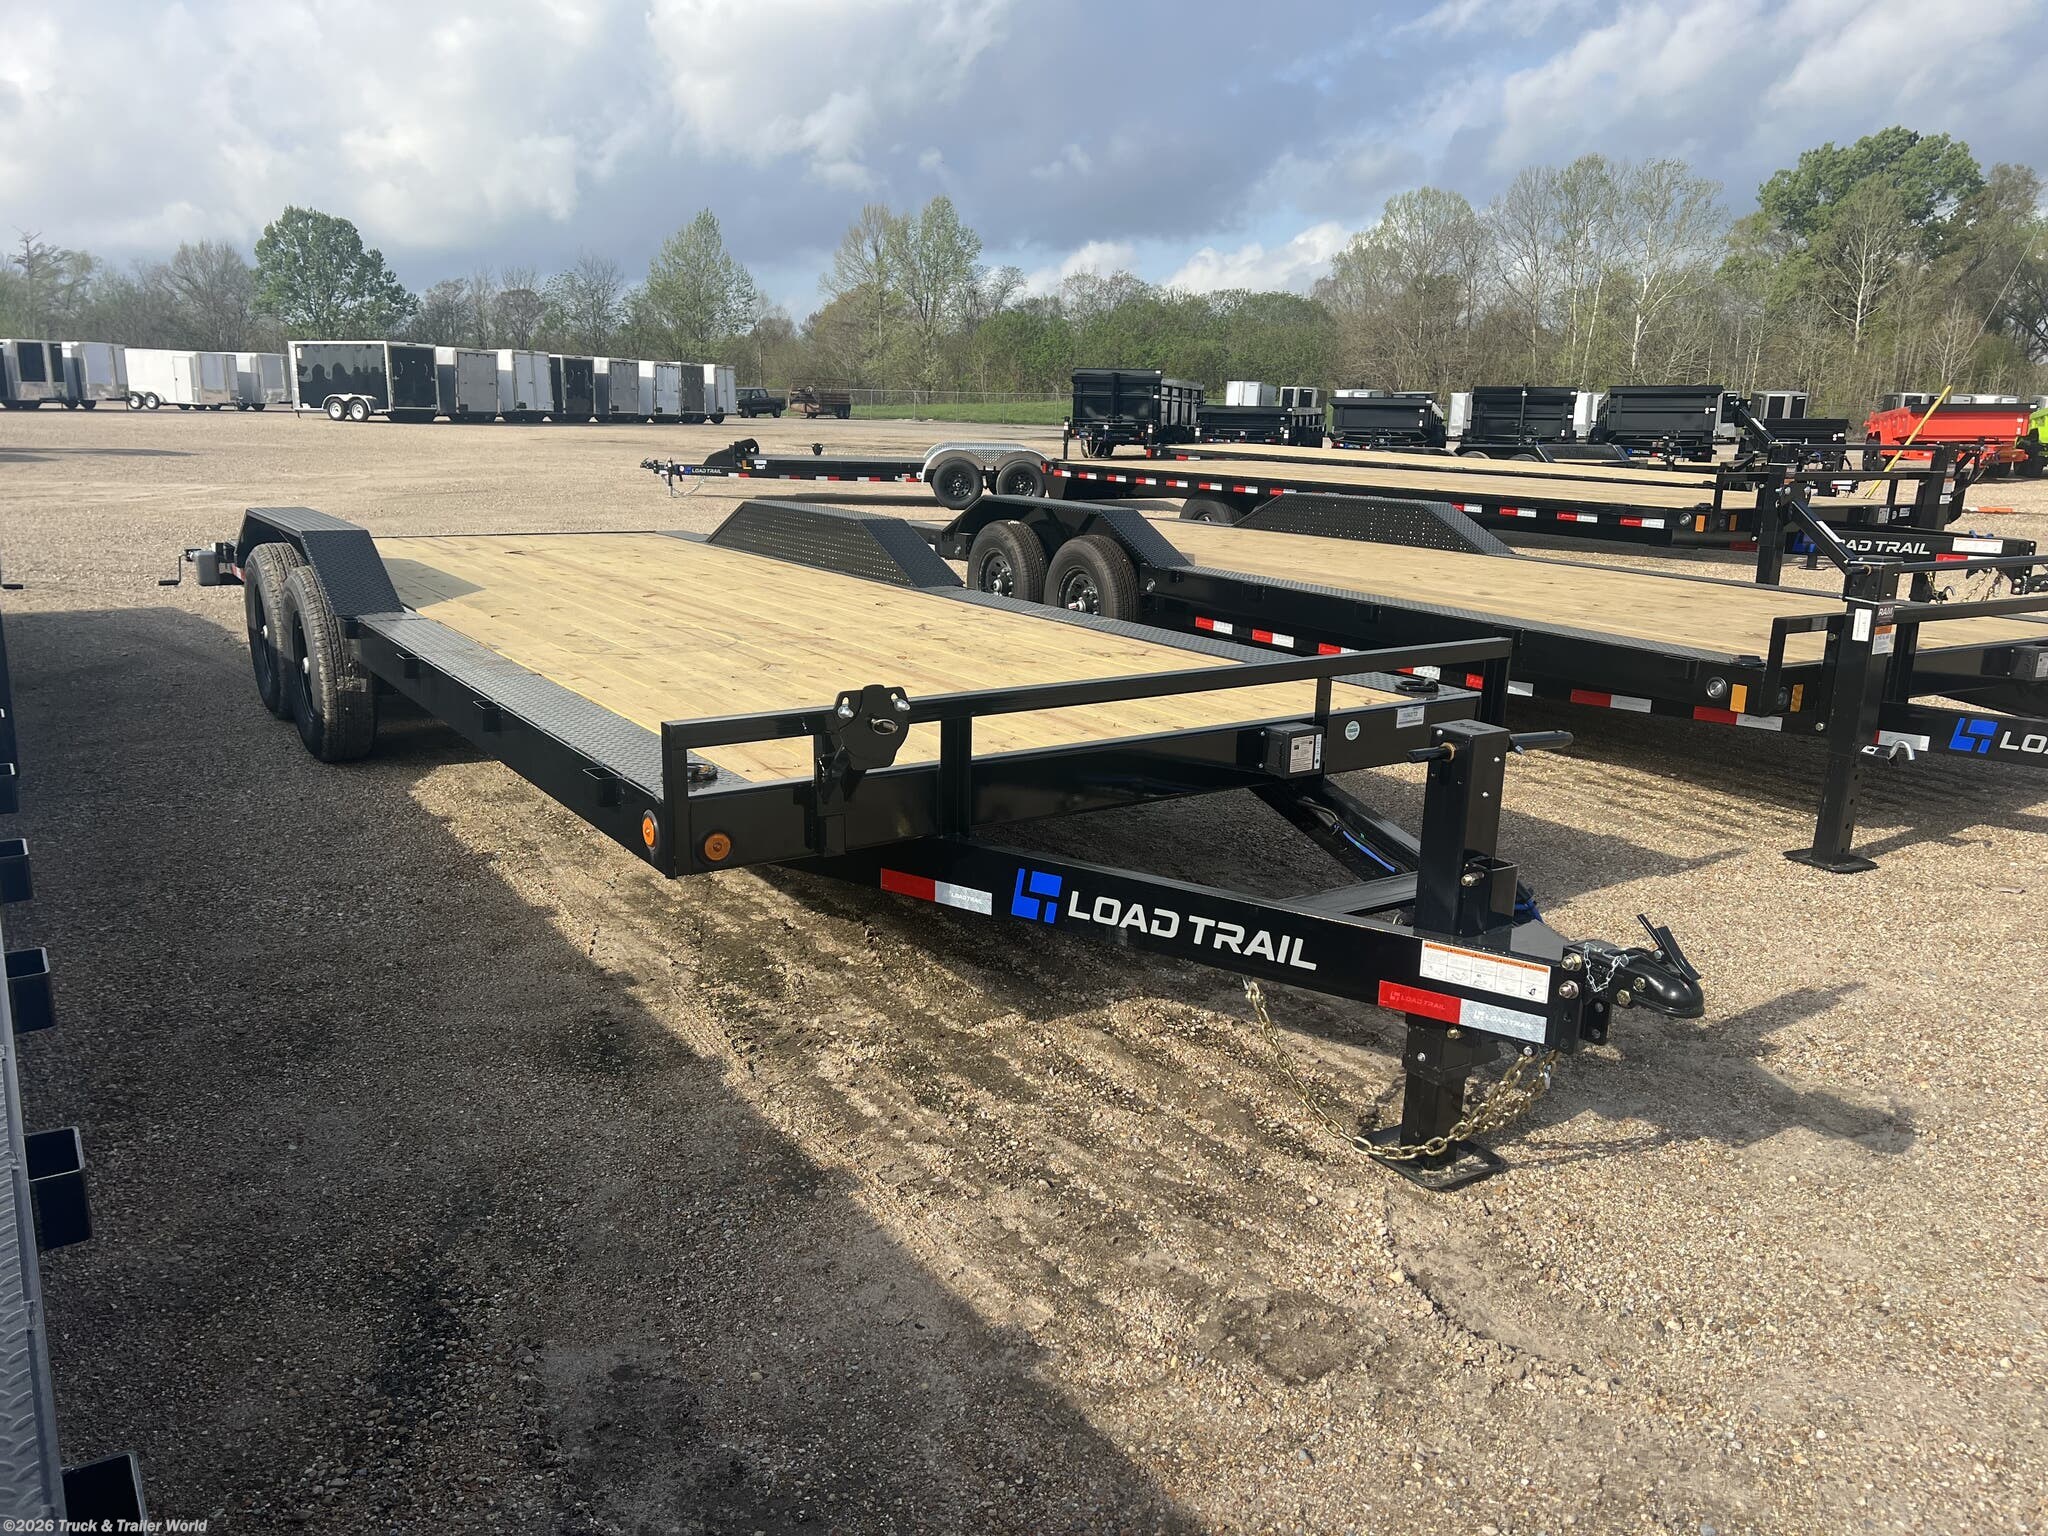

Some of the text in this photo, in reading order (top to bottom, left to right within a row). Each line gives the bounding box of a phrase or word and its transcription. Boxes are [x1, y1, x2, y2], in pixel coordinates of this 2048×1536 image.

[1840, 539, 1931, 555] AD TRAIL
[1878, 607, 1894, 616] RAM
[1999, 731, 2048, 755] LO
[1067, 890, 1317, 971] LOAD TRAIL
[1400, 995, 1446, 1010] LOAD TRAIL
[1485, 1014, 1532, 1030] LOAD TRAIL
